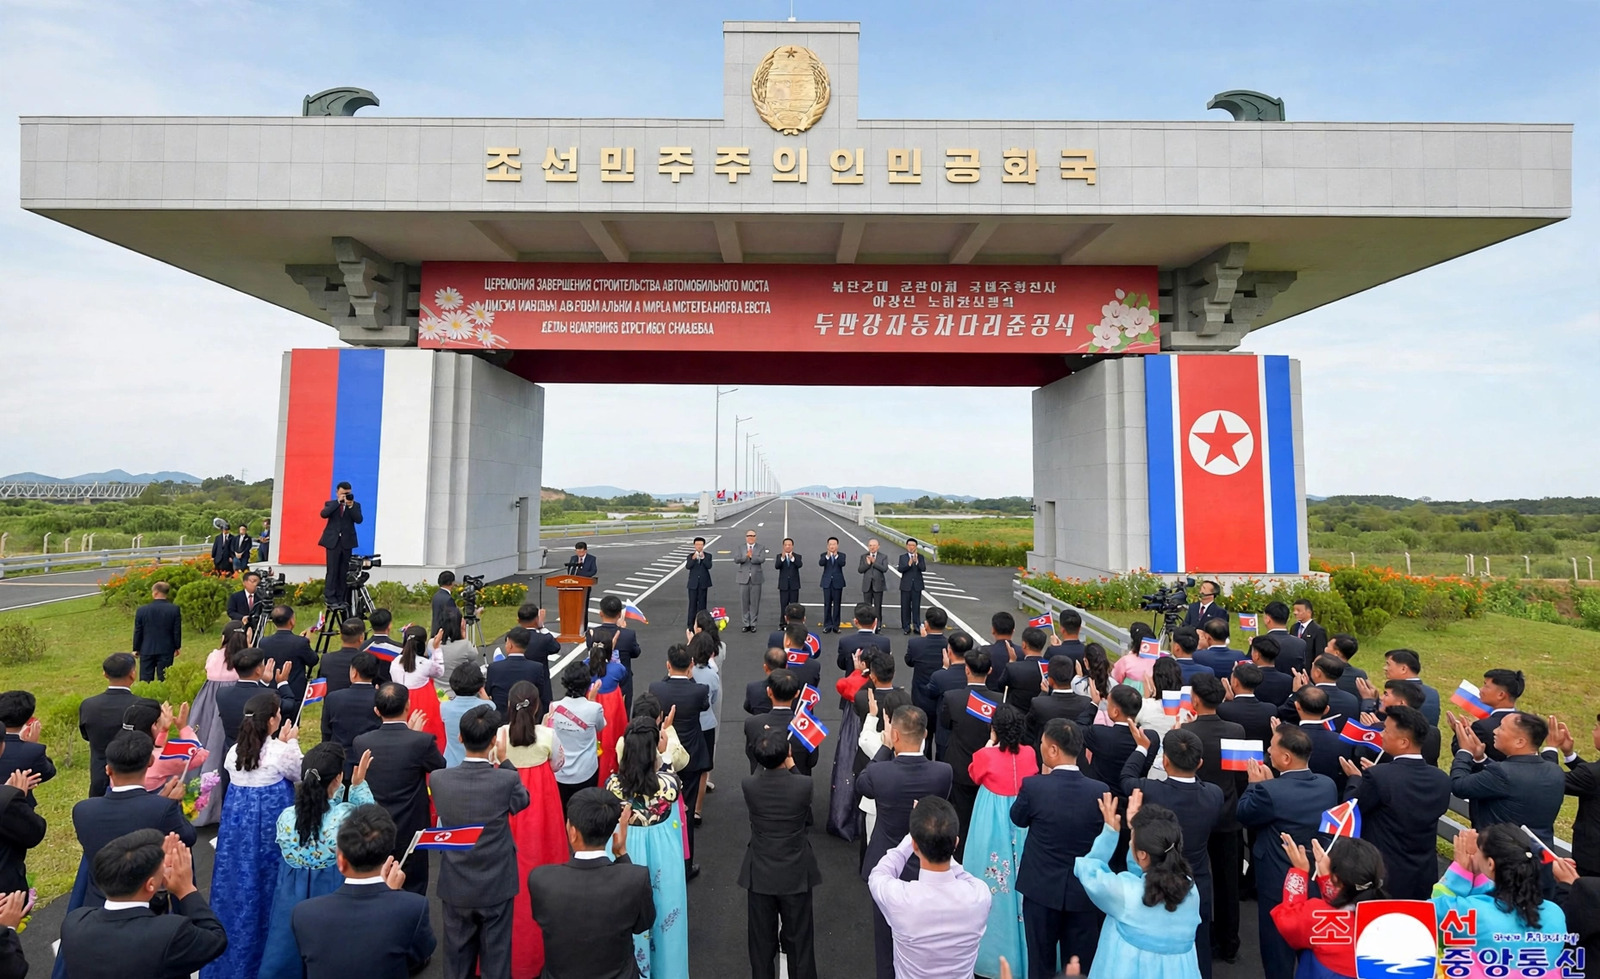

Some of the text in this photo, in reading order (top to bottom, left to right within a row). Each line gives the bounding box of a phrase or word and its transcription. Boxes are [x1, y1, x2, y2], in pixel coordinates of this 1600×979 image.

[485, 147, 1097, 185] 조선민주주의인민공화국
[484, 277, 769, 292] ЦЕРЕМОНИЯ ЗАВЕРШЕНИЯ СТРОИТЕЛЬСТВА АВТОМОБИЛЬНОГО МОСТА
[813, 313, 1075, 336] 두만강자동차다리준공식
